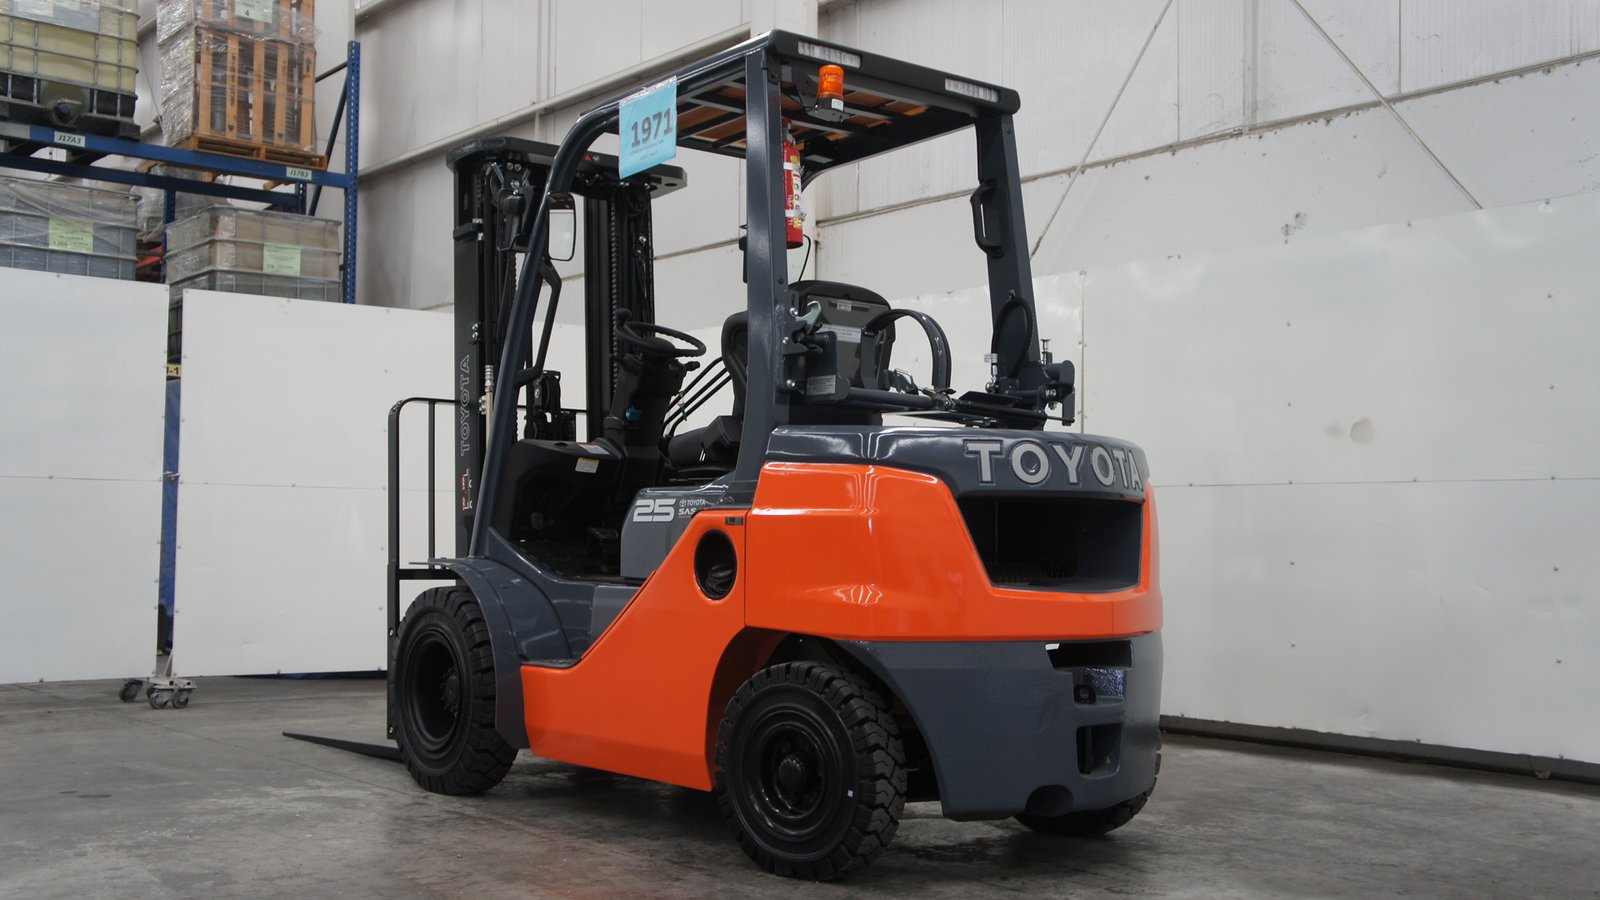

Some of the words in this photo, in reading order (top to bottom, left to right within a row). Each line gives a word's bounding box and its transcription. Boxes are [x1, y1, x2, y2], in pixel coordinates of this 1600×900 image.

[58, 135, 81, 144] J17A3
[632, 108, 672, 147] 1971
[460, 354, 470, 456] TOYOTA
[966, 443, 1142, 490] TOYOTA
[632, 498, 676, 522] 25
[678, 507, 696, 515] SAS
